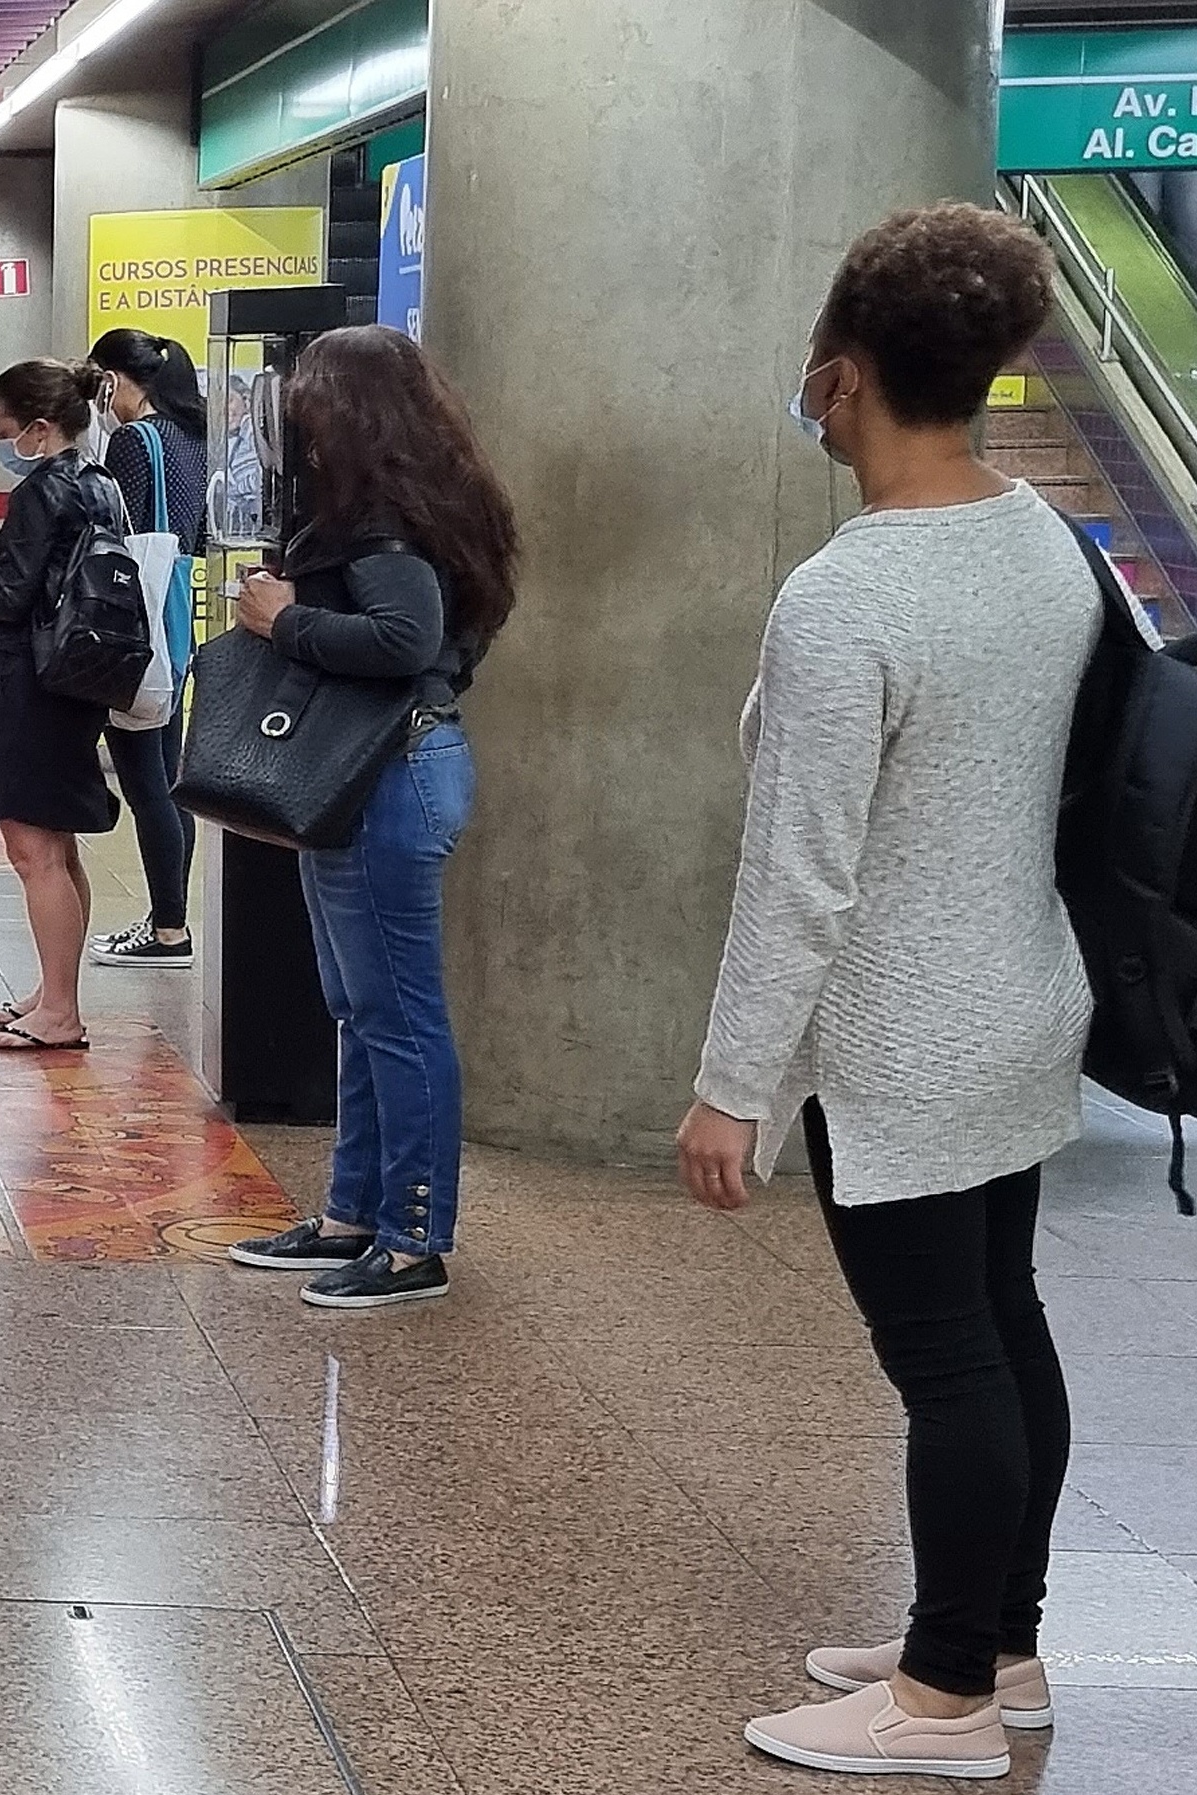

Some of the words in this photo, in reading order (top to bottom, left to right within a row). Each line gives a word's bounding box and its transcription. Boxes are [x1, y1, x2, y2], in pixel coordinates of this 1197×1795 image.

[1112, 86, 1176, 118] Av.
[1082, 127, 1135, 159] Al.
[99, 259, 188, 281] CURSOS
[195, 255, 318, 278] PRESENCIAIS
[100, 292, 111, 310] E
[116, 291, 131, 310] A
